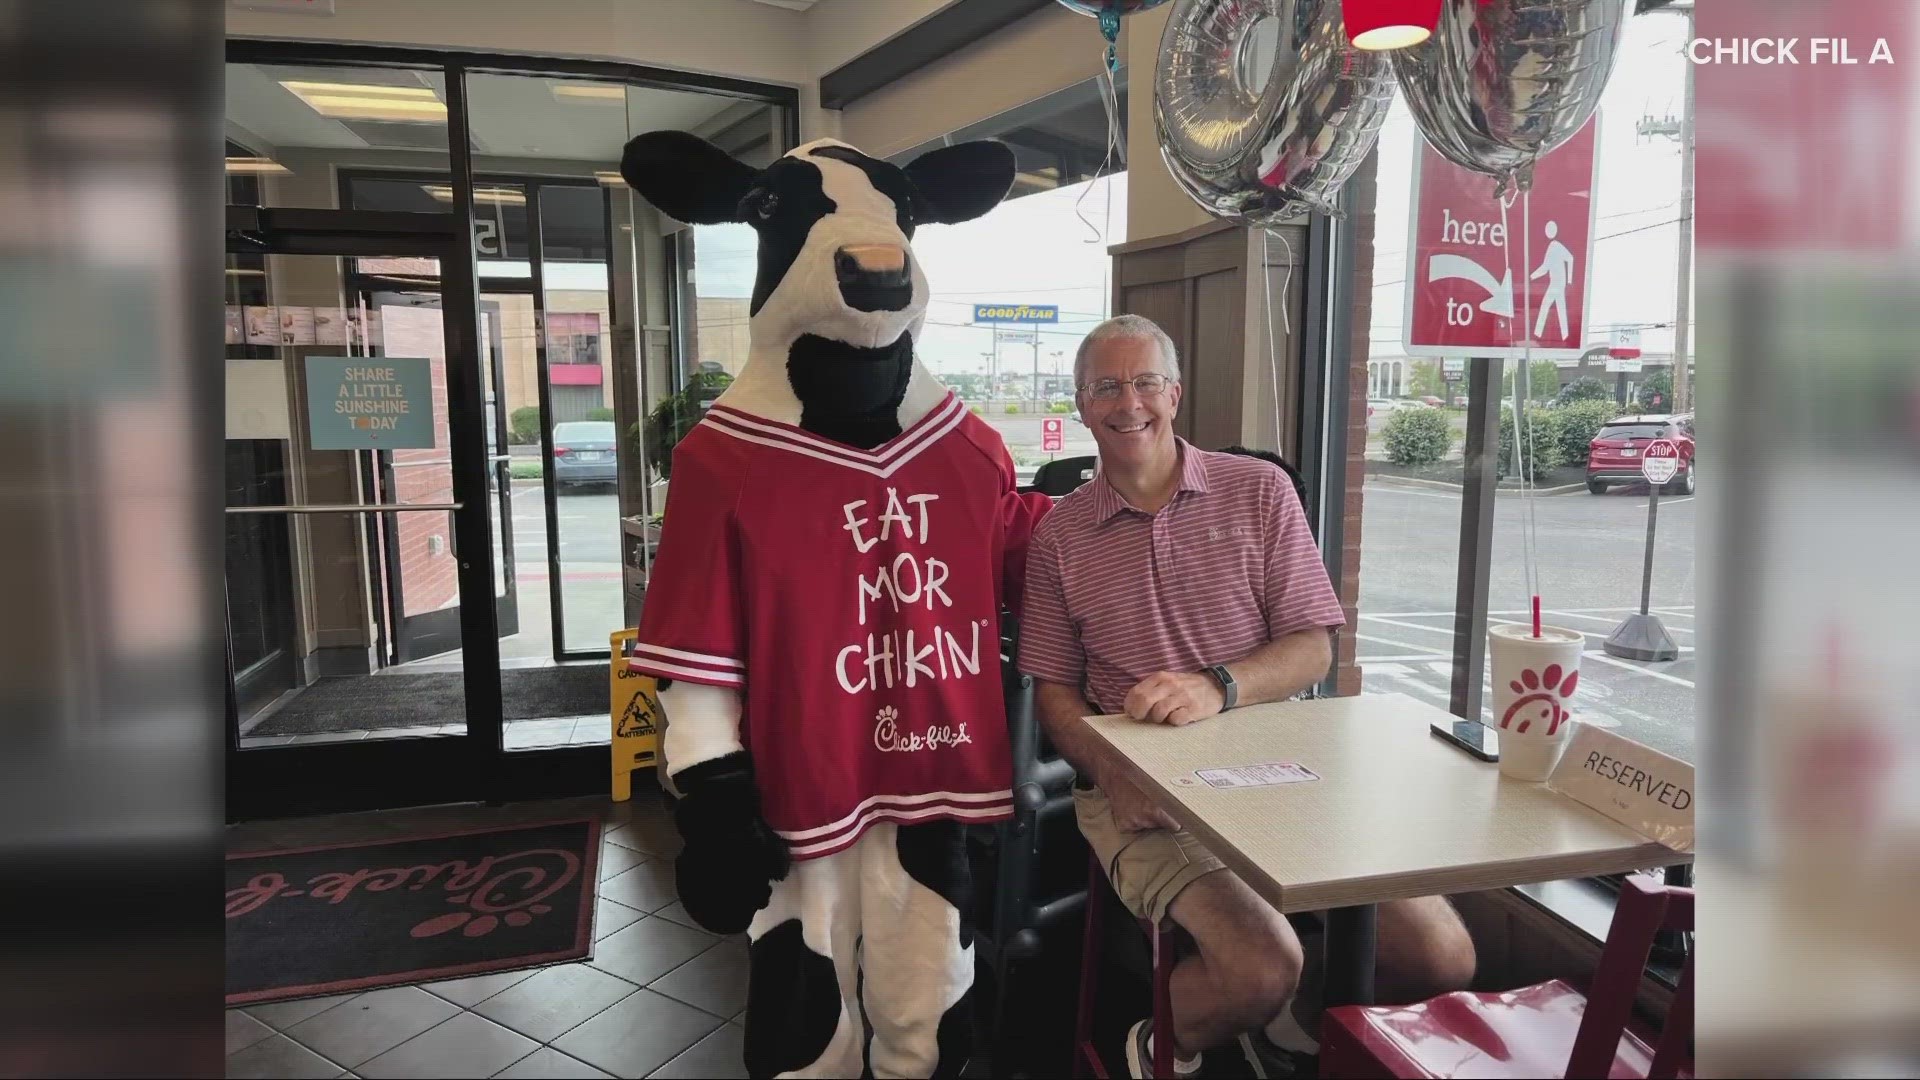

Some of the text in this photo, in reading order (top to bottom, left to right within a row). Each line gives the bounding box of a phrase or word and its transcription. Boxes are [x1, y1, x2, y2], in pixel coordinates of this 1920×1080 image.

[1441, 209, 1505, 246] here
[977, 307, 1055, 321] GOODYEAR
[1446, 298, 1473, 326] to
[345, 367, 395, 381] SHARE
[339, 384, 403, 397] A LITTLE
[334, 400, 410, 414] SUNSHINE
[348, 416, 398, 431] TODAY
[1650, 445, 1672, 456] STOP
[842, 487, 940, 553] EAT
[857, 552, 953, 626] MOR
[874, 708, 972, 752] Chick-fil-A
[1584, 750, 1691, 812] RESERVED
